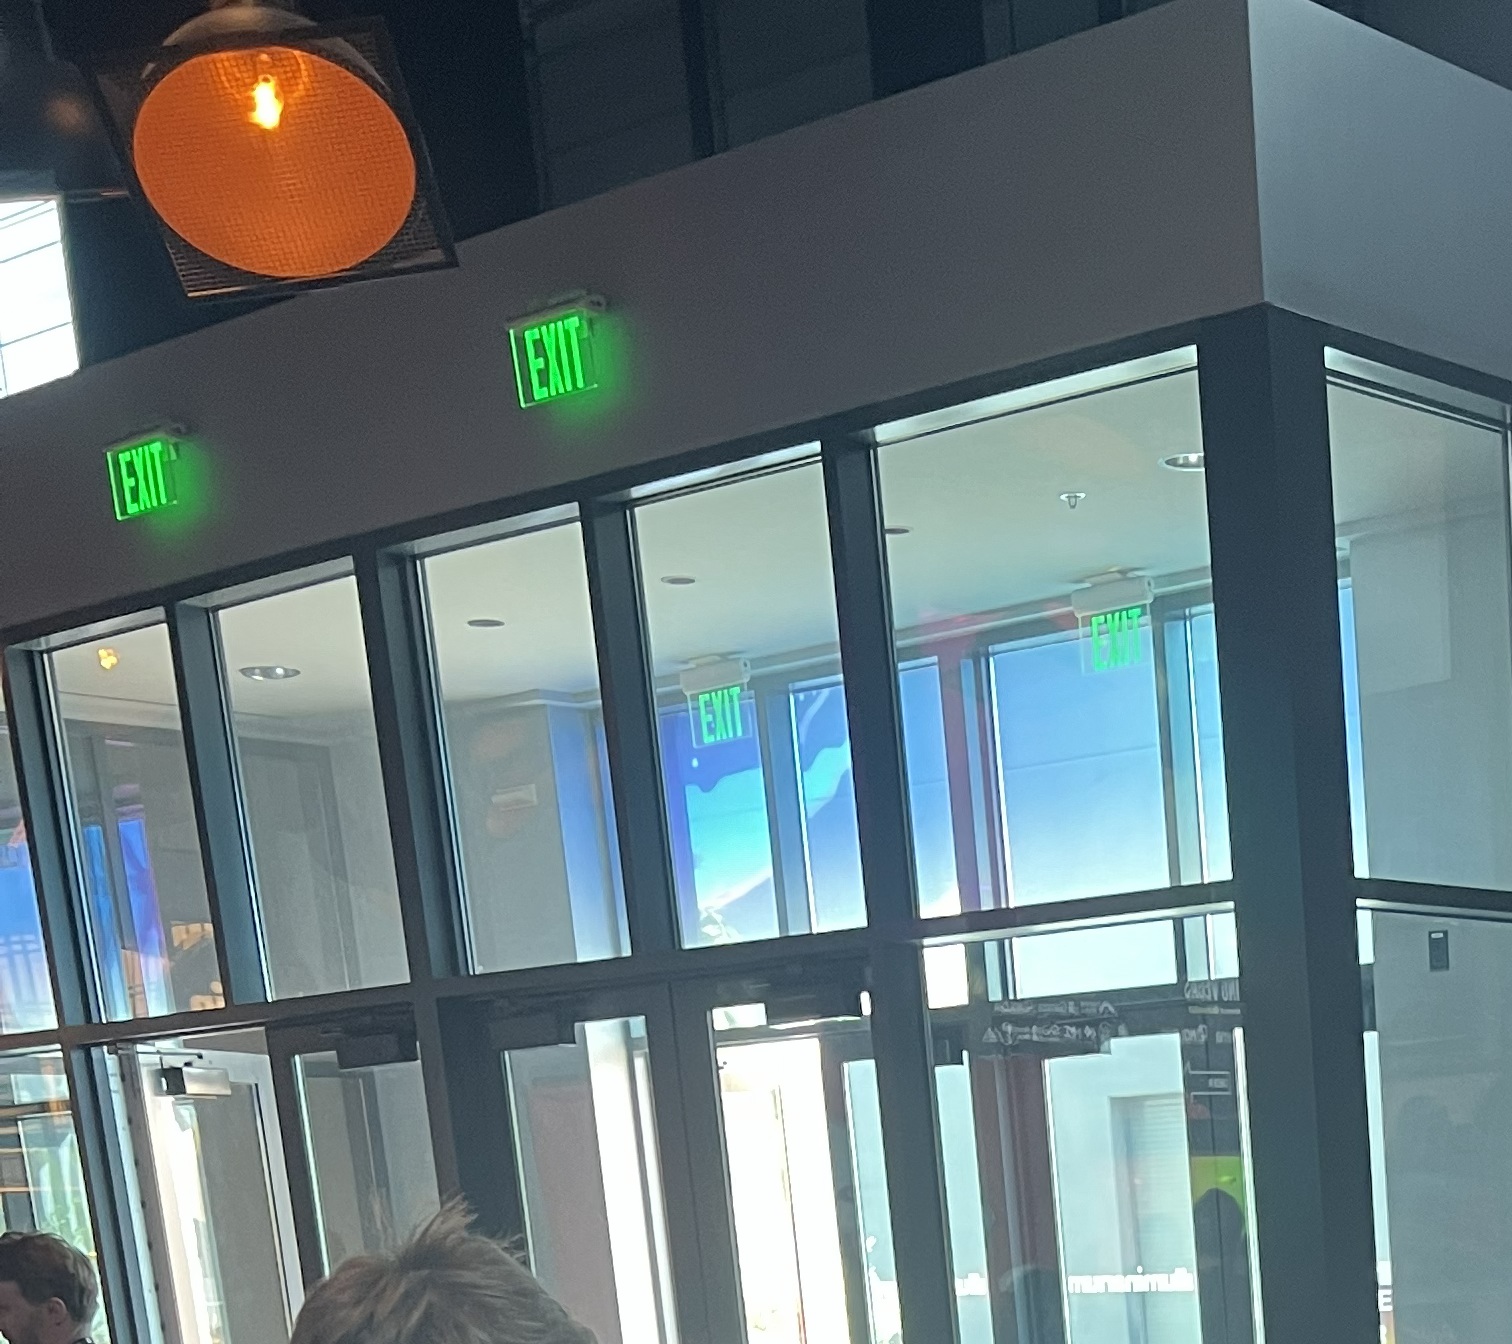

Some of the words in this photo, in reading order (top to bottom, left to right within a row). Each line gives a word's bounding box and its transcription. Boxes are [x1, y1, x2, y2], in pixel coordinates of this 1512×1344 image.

[524, 315, 588, 400] EXIT
[118, 441, 168, 514] EXIT
[1090, 607, 1142, 672] EXIT
[699, 685, 743, 745] EXIT
